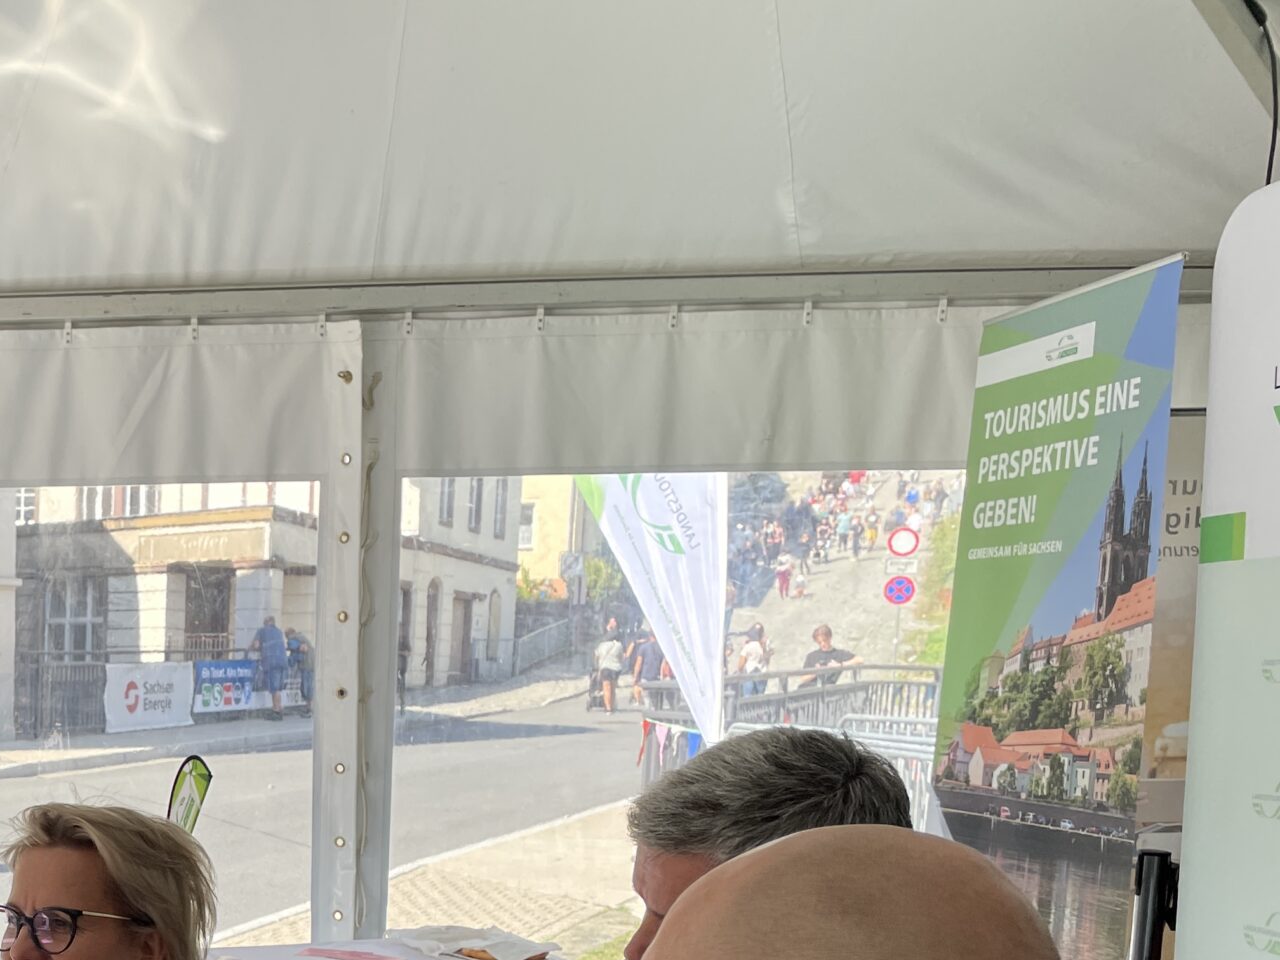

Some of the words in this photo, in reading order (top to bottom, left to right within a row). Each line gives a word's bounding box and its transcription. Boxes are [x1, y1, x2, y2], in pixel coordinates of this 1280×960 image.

[984, 389, 1091, 440] TOURISMUS
[1095, 377, 1141, 417] EINE
[978, 436, 1100, 484] PERSPEKTIVE
[973, 495, 1037, 529] GEBEN!
[968, 545, 1012, 560] GEMEINSAM
[1013, 542, 1028, 556] FÜR
[1028, 540, 1063, 555] SACHSEN
[143, 680, 175, 695] Sachsen
[143, 697, 172, 713] Energie
